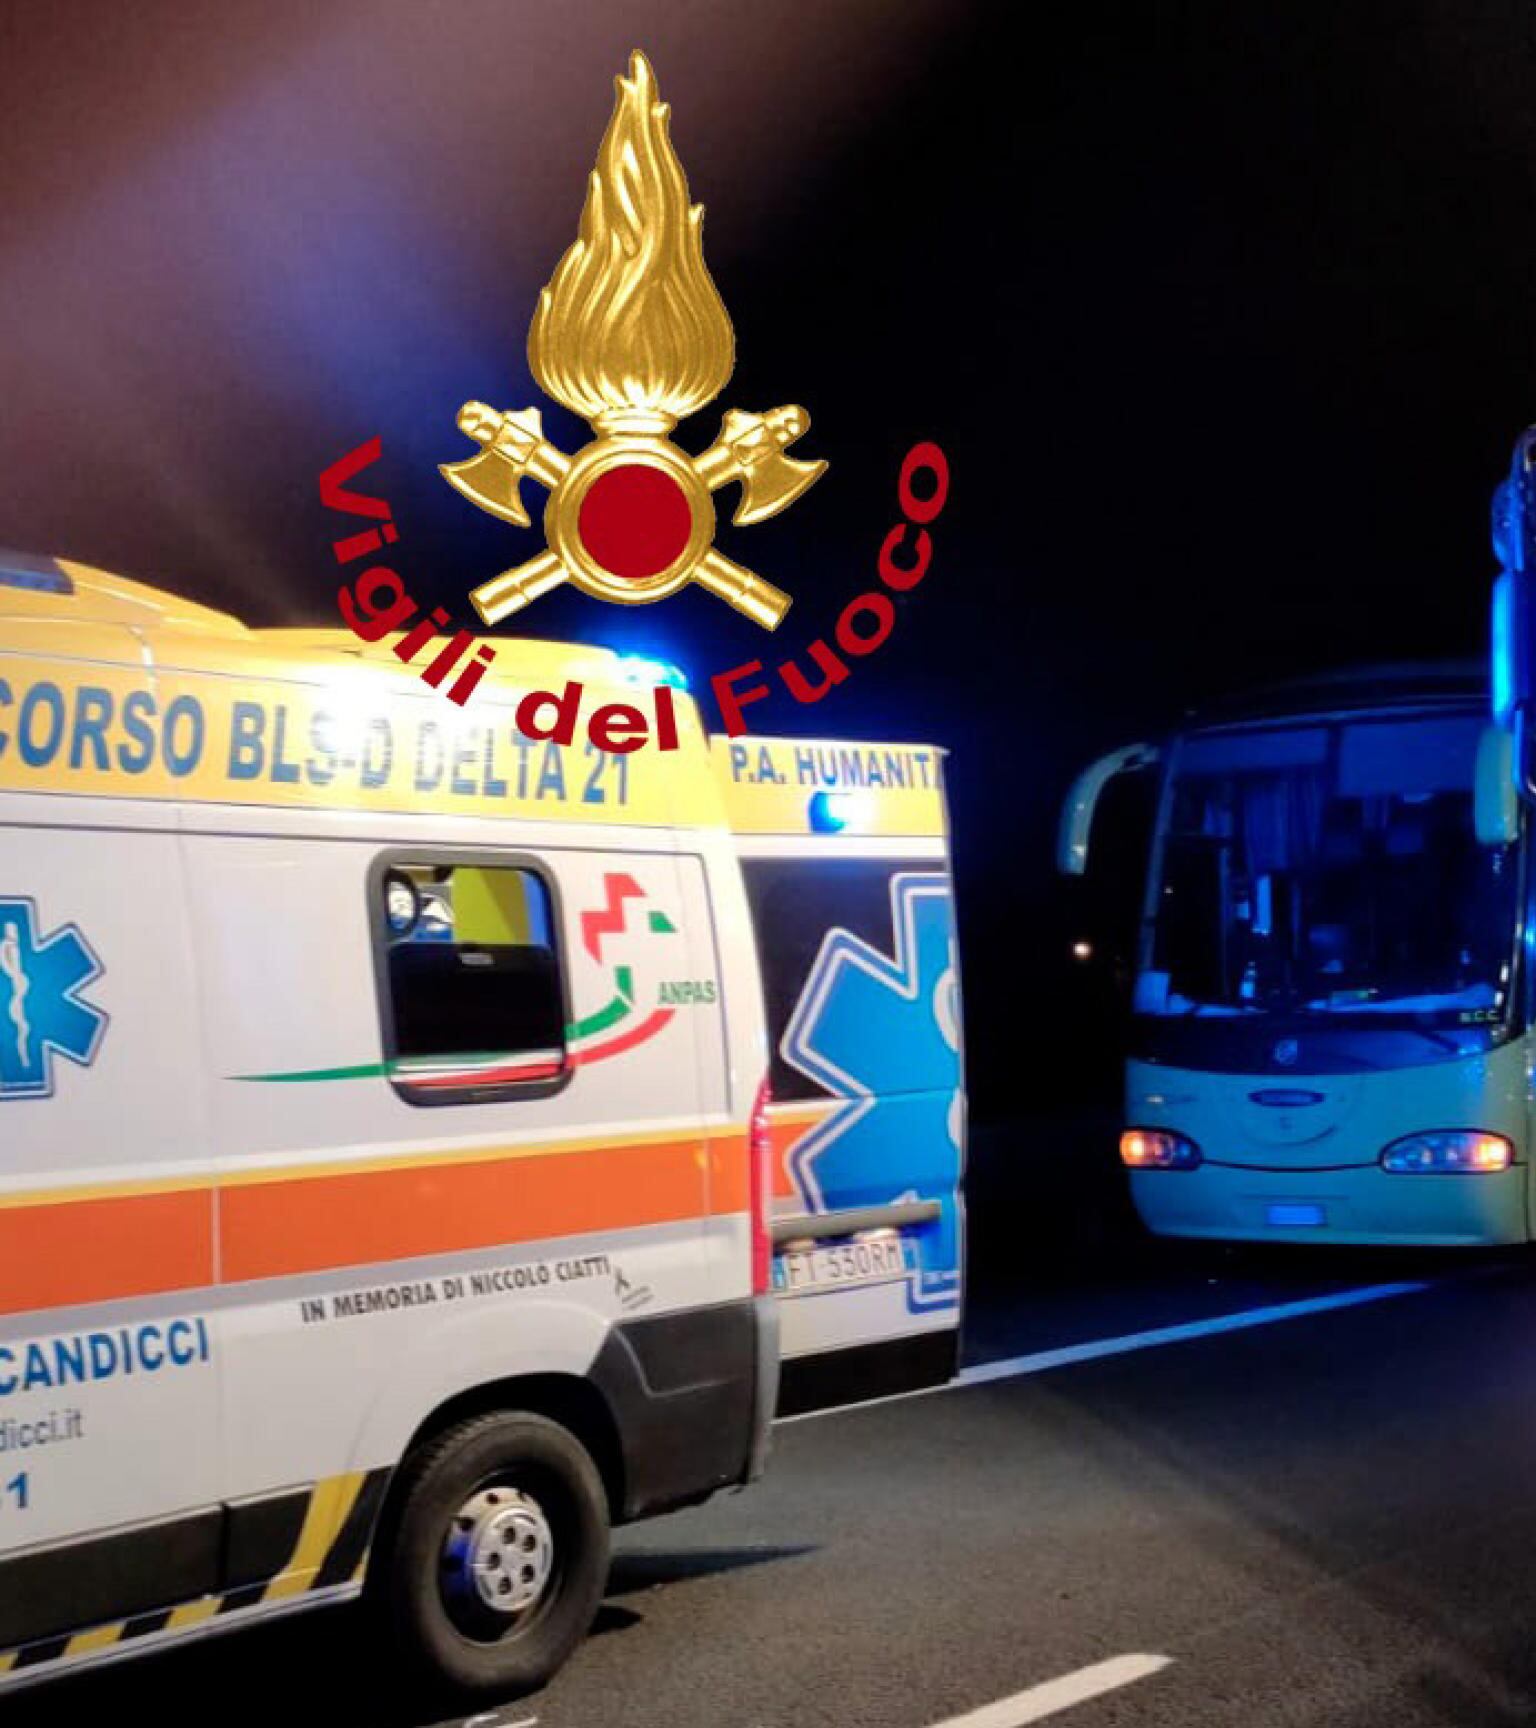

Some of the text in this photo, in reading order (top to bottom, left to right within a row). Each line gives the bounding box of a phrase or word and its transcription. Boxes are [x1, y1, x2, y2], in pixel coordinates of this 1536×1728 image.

[414, 719, 567, 801] DELTA
[581, 735, 628, 805] 21
[729, 744, 787, 784] P.A.
[656, 980, 716, 1005] ANPAS
[300, 1300, 326, 1323] IN
[333, 1282, 437, 1318] MEMORIA
[442, 1278, 465, 1301] DI
[555, 1254, 611, 1282] CIATTI
